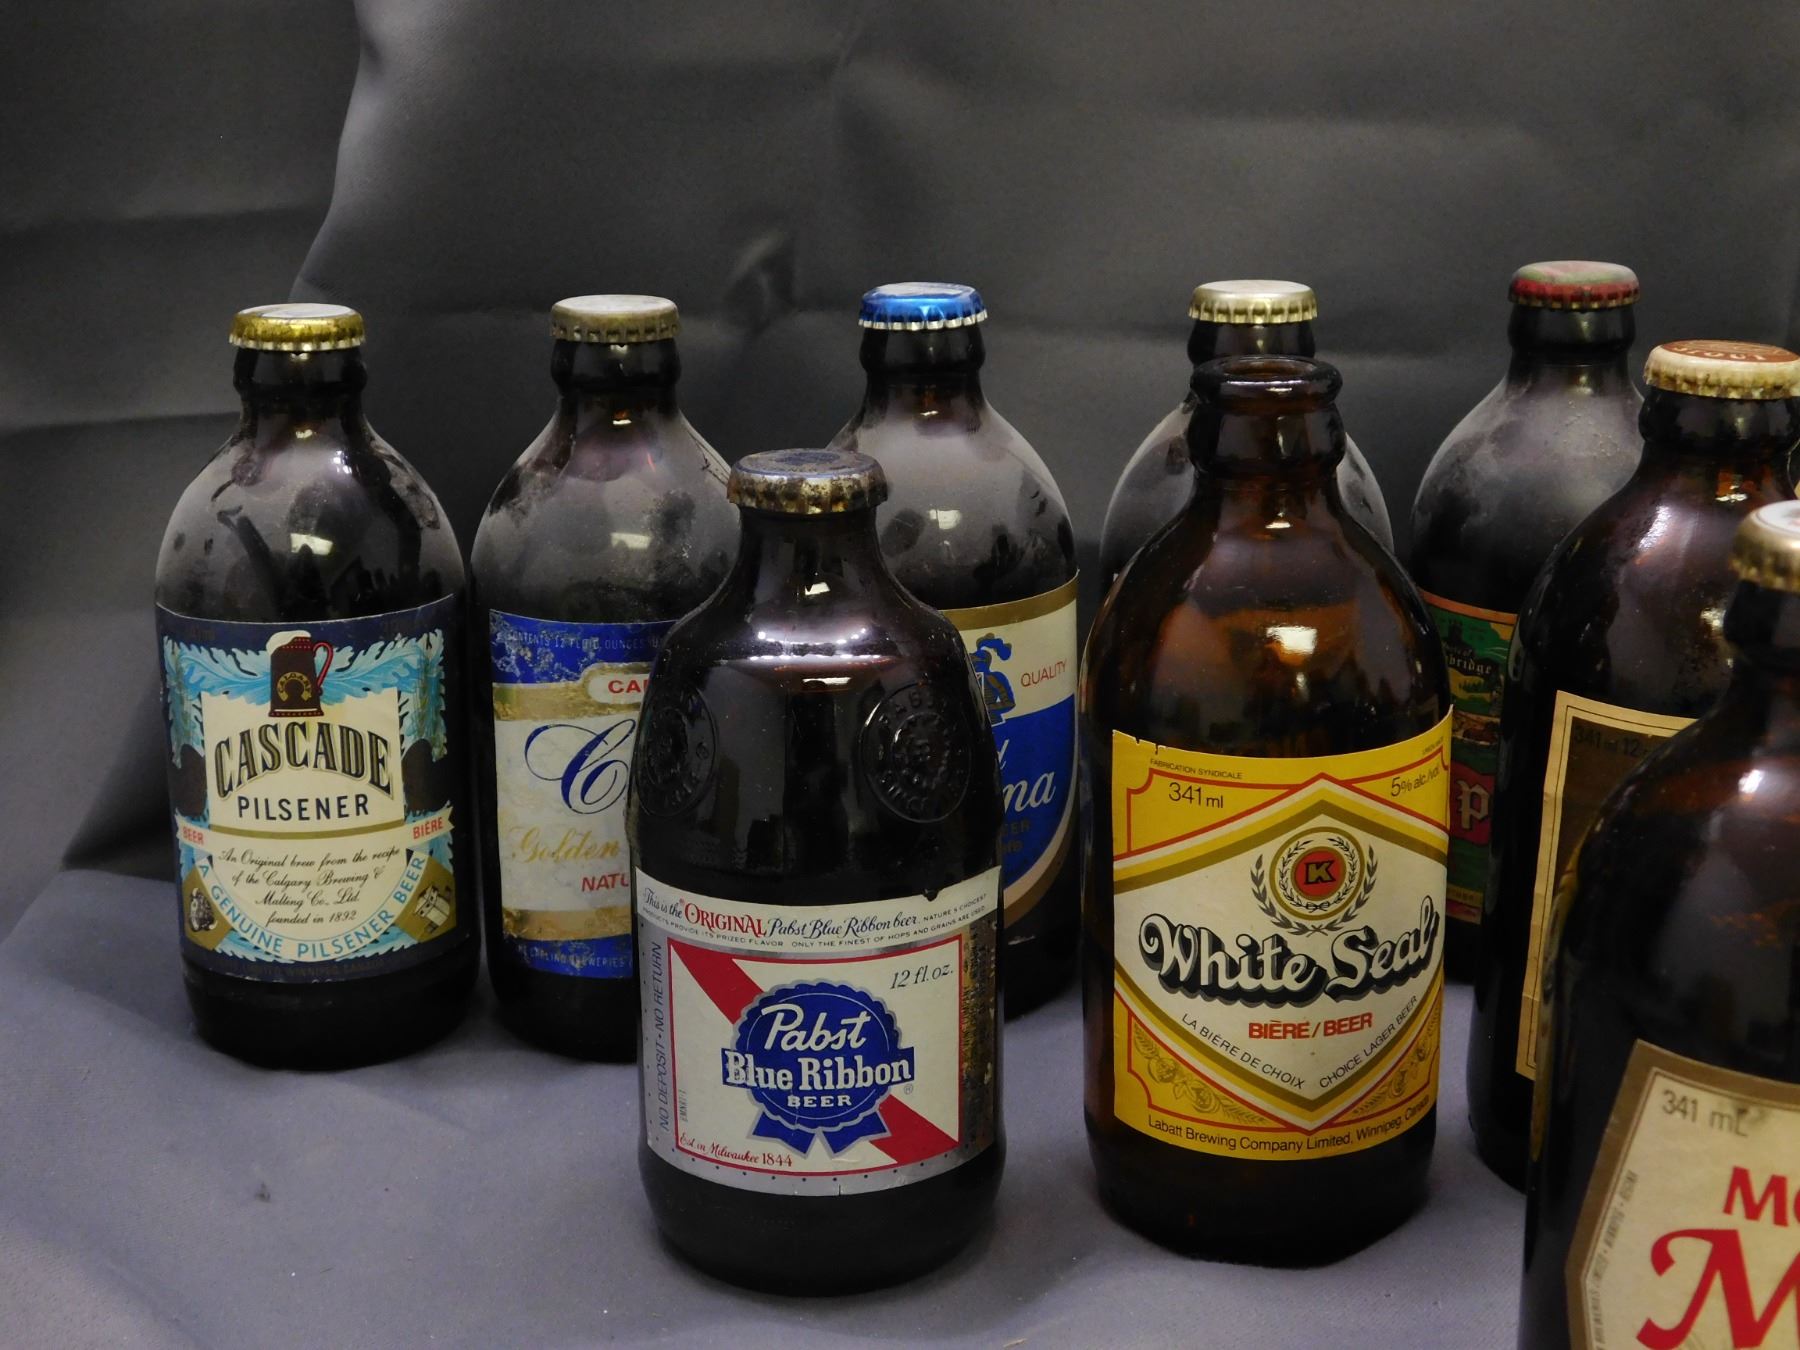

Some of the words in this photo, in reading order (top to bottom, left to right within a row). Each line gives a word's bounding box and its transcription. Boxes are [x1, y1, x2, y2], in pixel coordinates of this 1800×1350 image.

[1020, 658, 1067, 688] QUALITY
[214, 721, 394, 799] CASCADE
[1149, 758, 1197, 776] FABRICATION
[1198, 767, 1243, 780] SYNDICALE
[238, 793, 369, 821] PILSENER
[182, 826, 204, 846] BEER
[511, 826, 621, 864] Golden
[218, 848, 237, 862] An
[241, 849, 289, 872] Original
[290, 854, 315, 867] brew
[318, 853, 348, 871] from
[352, 849, 368, 862] the
[372, 845, 400, 861] recipe
[1305, 860, 1335, 885] K
[232, 870, 244, 887] of
[245, 873, 260, 884] the
[262, 870, 311, 892] Calgary
[317, 870, 369, 888] Brewing
[198, 864, 210, 878] A
[211, 884, 284, 957] GENUINE
[297, 908, 395, 959] PILSENER
[394, 856, 426, 905] BEER
[255, 891, 304, 912] Malting
[643, 887, 660, 908] This
[660, 901, 668, 914] is
[669, 902, 683, 919] the
[685, 902, 767, 938] ORIGINAL
[767, 917, 806, 938] Pabst
[803, 918, 843, 939] Blue
[838, 916, 891, 939] Ribbon
[959, 893, 987, 911] CHOICEST
[266, 911, 309, 927] founded
[313, 913, 324, 923] in
[329, 910, 358, 923] 1892
[671, 921, 699, 935] PROVIDE
[716, 934, 746, 944] PRIZED
[749, 938, 784, 947] FLAVOR
[838, 938, 870, 946] FINEST
[874, 936, 885, 944] OF
[888, 931, 911, 941] HOPS
[913, 927, 929, 936] AND
[931, 919, 957, 931] GRAINS
[957, 914, 969, 922] ARE
[1139, 913, 1326, 1006] White
[1325, 895, 1440, 1002] Seal
[651, 941, 664, 1005] RETURN
[889, 969, 911, 990] 12
[931, 964, 954, 980] oz.
[653, 1009, 664, 1032] NO
[760, 1003, 871, 1052] Pabst
[1323, 1012, 1373, 1037] BEER
[1182, 1012, 1198, 1028] LA
[1240, 1052, 1260, 1069] DE
[1261, 1062, 1306, 1090] CHOIX
[1319, 1053, 1361, 1089] CHOICE
[1362, 1023, 1396, 1057] LAGER
[1395, 994, 1418, 1026] BEER
[655, 1041, 668, 1104] DEPOSIT
[724, 1050, 793, 1091] Blue
[798, 1057, 911, 1091] Ribbon
[787, 1094, 852, 1108] BEER
[1661, 1088, 1700, 1123] 341
[659, 1109, 669, 1131] NO
[1147, 1113, 1183, 1136] Labatt
[1186, 1126, 1237, 1150] Brewing
[1239, 1136, 1304, 1154] Company
[697, 1141, 706, 1150] in
[705, 1142, 759, 1164] Milwaukee
[762, 1153, 792, 1166] 1844
[1722, 1165, 1800, 1228] M
